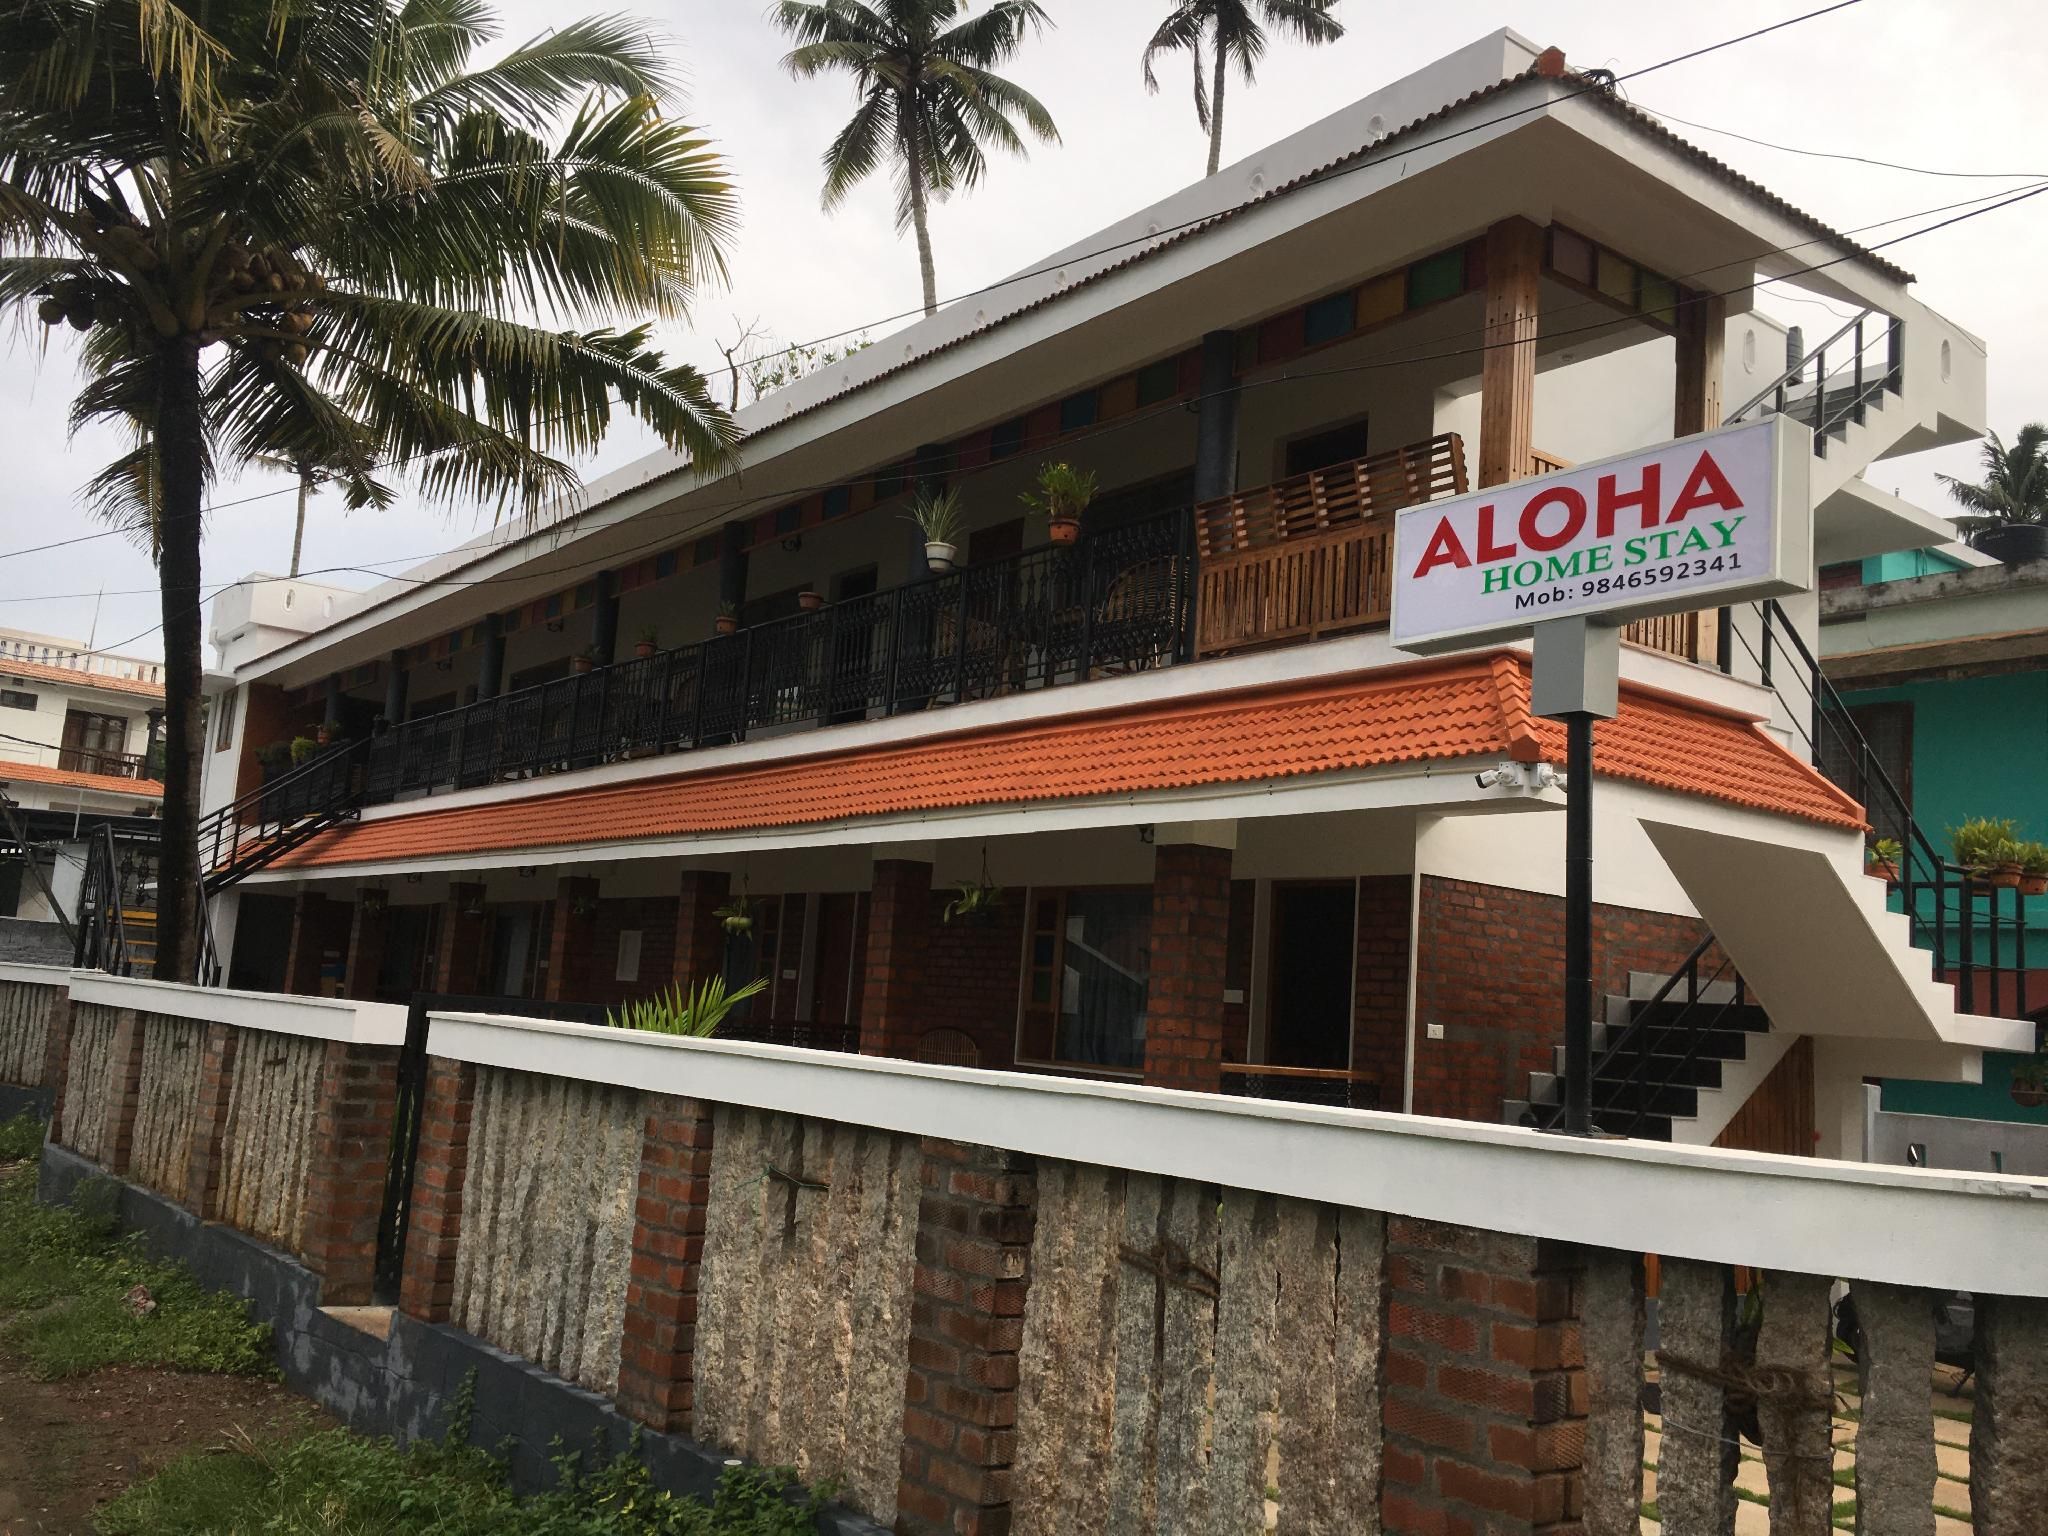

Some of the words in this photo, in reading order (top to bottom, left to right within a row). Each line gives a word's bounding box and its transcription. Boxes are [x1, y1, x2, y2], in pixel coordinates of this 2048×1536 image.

[1413, 449, 1744, 579] ALOHA
[1481, 545, 1613, 594] HOME
[1625, 516, 1746, 566] STAY
[1515, 585, 1573, 610] Mob:
[1582, 553, 1742, 597] 9846592341
